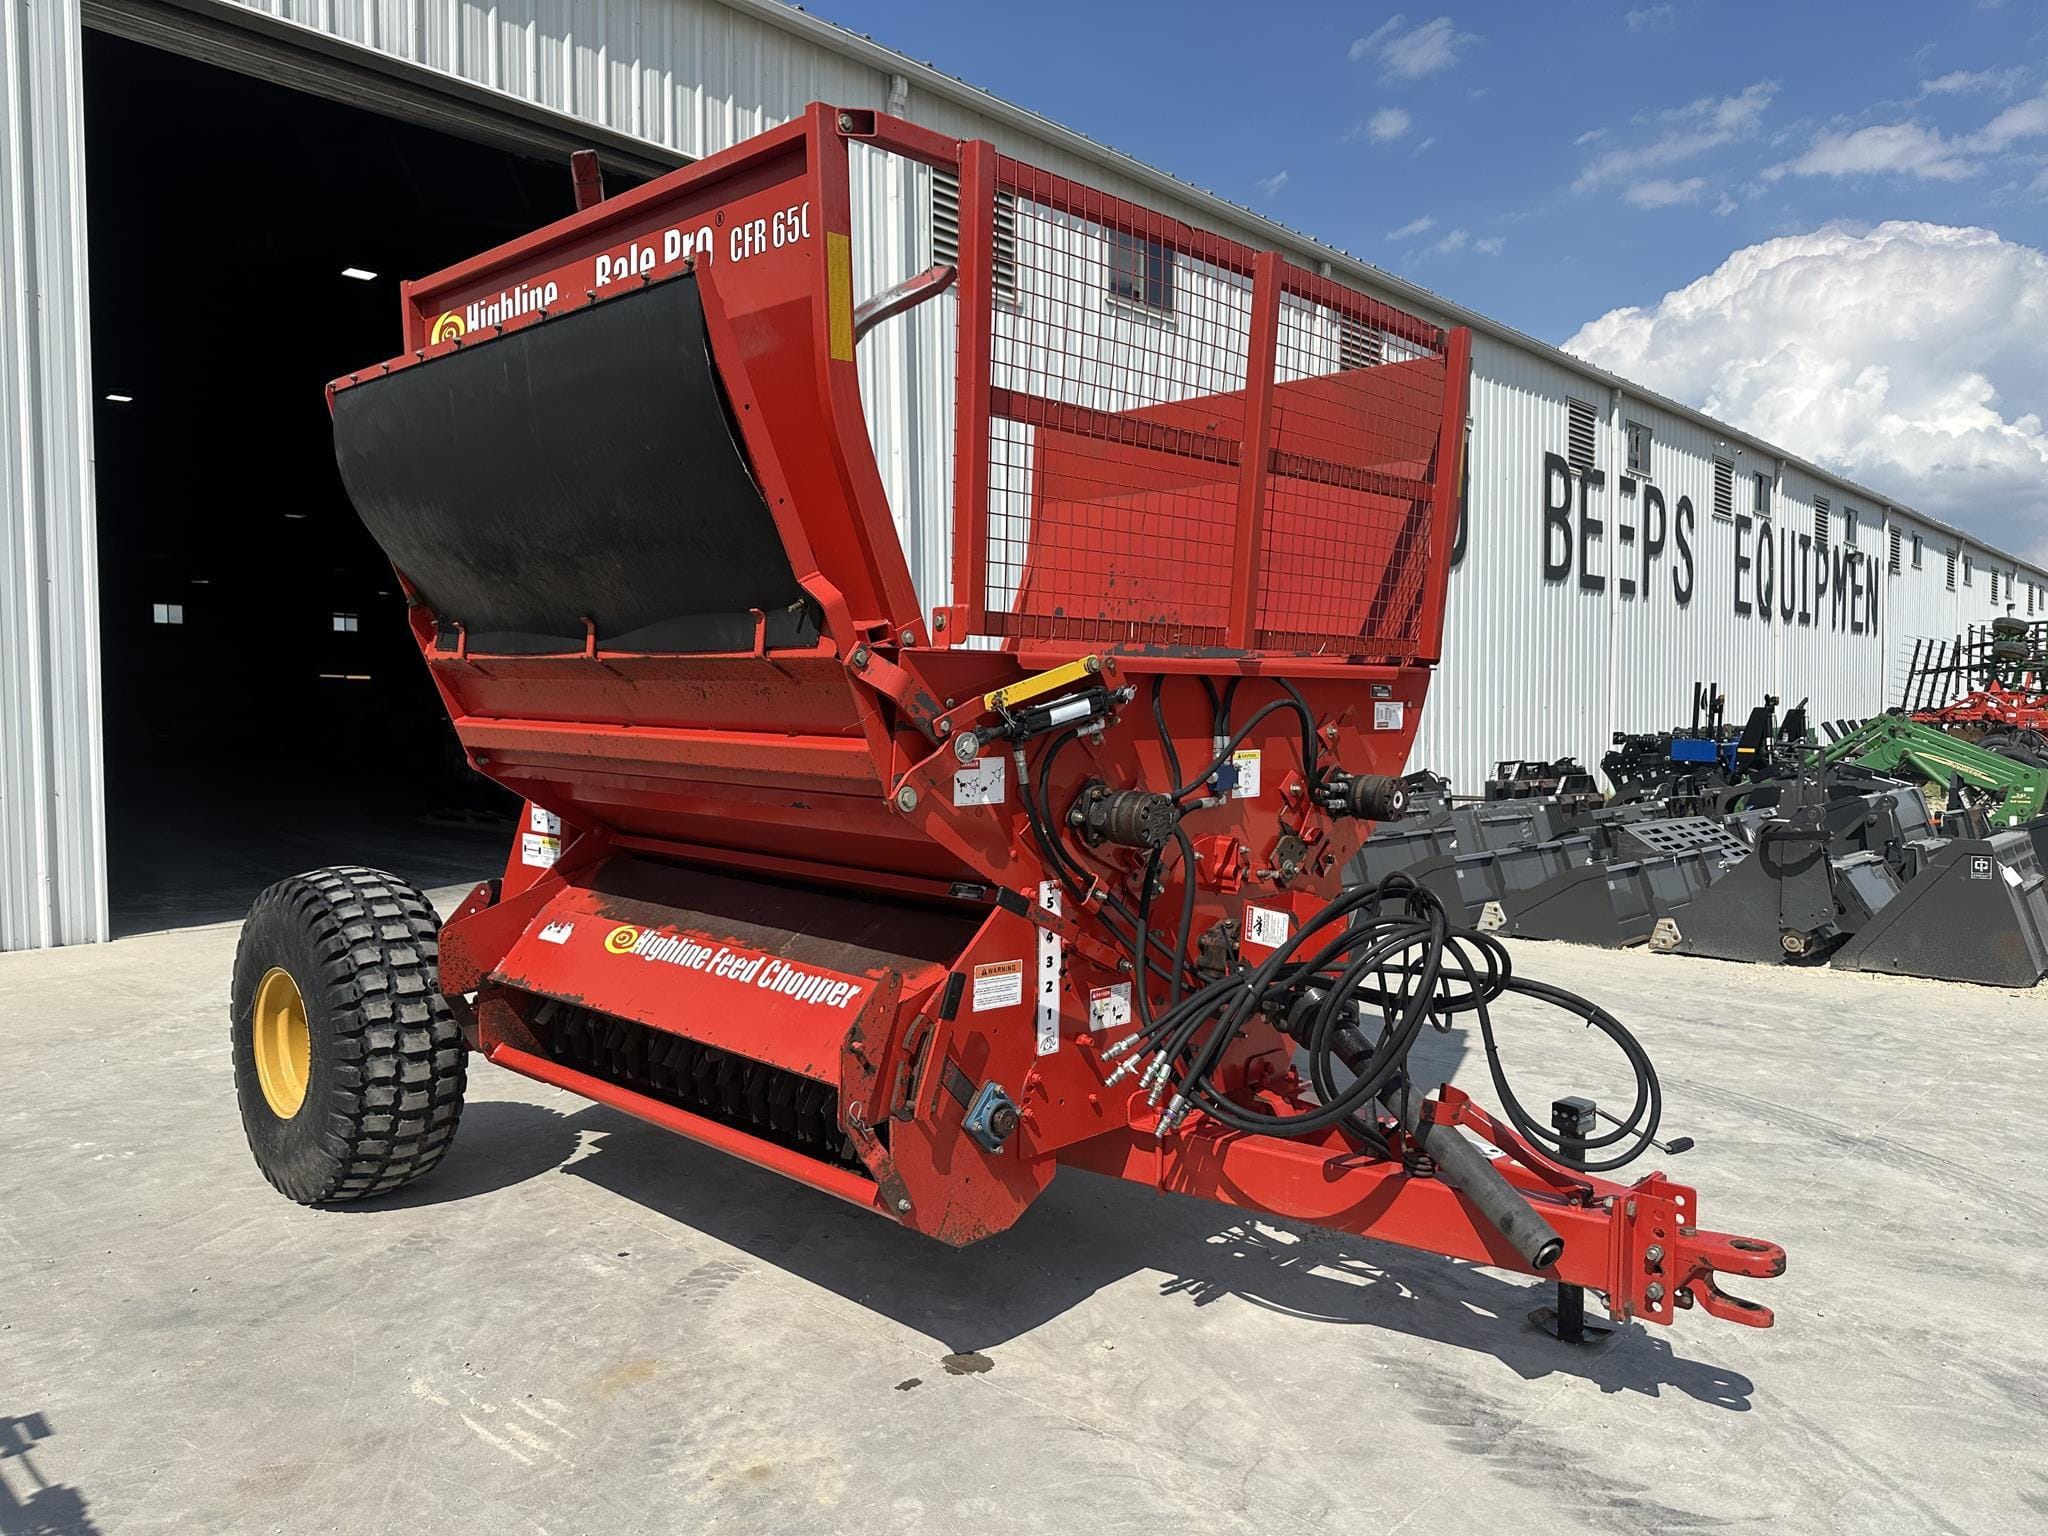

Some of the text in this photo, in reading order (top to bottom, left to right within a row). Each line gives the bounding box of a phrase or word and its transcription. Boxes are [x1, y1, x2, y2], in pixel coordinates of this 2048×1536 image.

[730, 218, 767, 263] CFR
[465, 226, 714, 333] Highline Bale Pro
[1544, 451, 1694, 604] BEEPS
[1735, 514, 1892, 639] EQUIPMEN
[1046, 896, 1054, 909] 5
[1046, 932, 1054, 944] 4
[629, 929, 862, 1009] Highline Feed Chopper
[988, 964, 1016, 974] WARNING
[1045, 956, 1053, 969] 3
[1045, 980, 1053, 993] 2
[1046, 1008, 1052, 1020] 1
